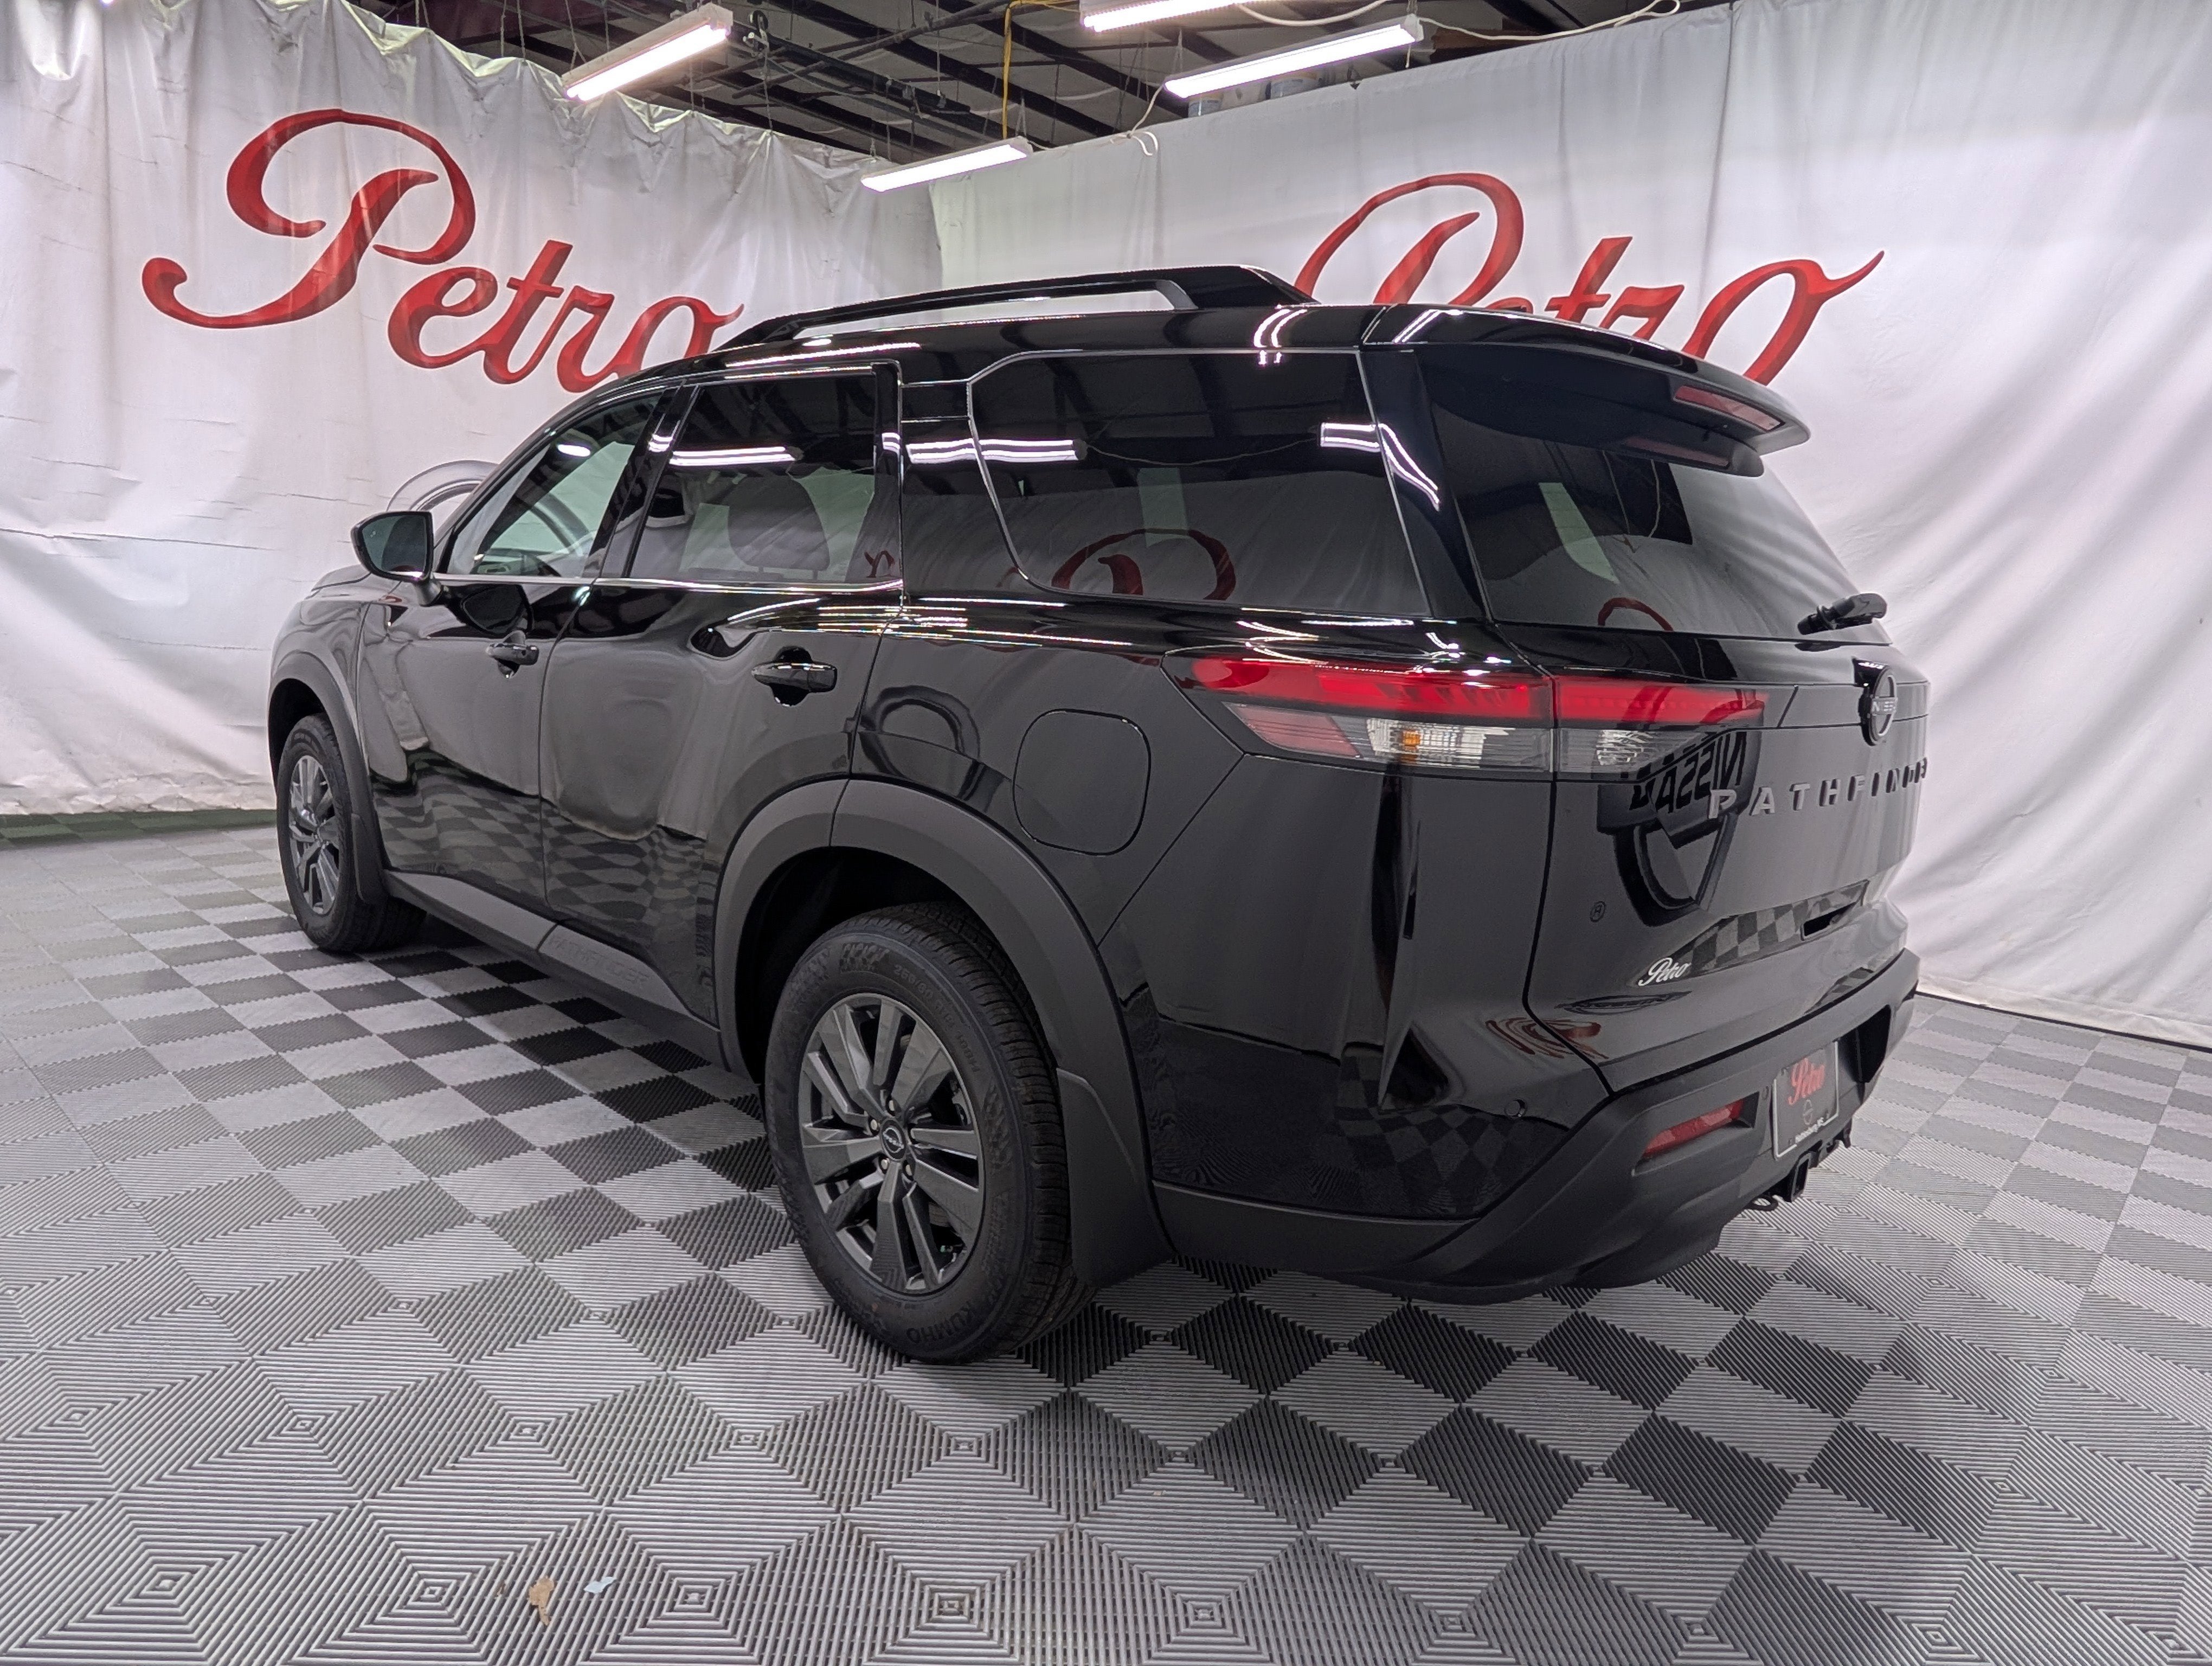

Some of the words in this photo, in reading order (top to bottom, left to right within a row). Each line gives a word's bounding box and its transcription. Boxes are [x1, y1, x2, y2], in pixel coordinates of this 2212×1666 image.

[142, 108, 744, 393] Petro
[1295, 172, 1885, 385] Ptro
[906, 1299, 978, 1344] KUMHO
